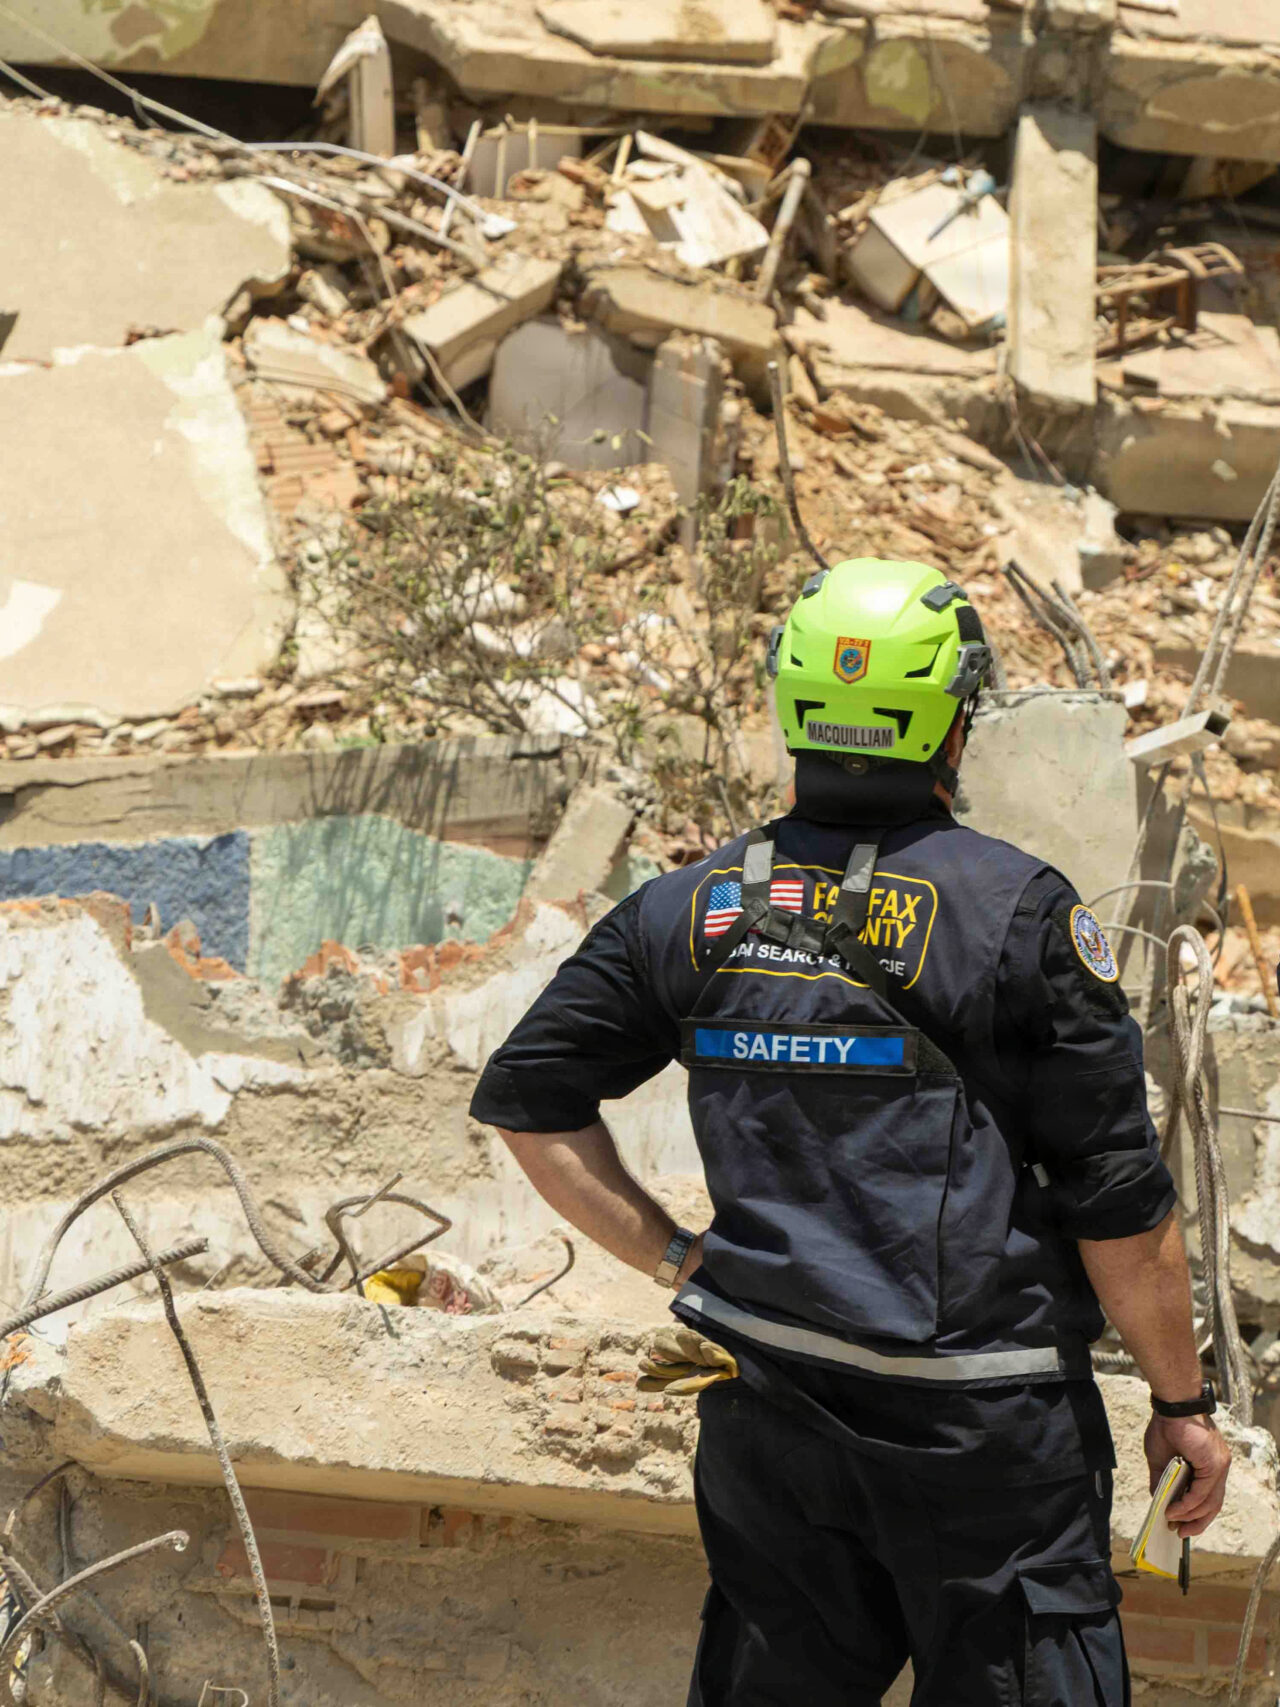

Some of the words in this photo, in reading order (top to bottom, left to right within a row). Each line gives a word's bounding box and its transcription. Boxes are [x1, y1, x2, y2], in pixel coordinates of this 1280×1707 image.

[807, 722, 893, 747] MACQUILLIAM
[813, 882, 922, 923] FAFAX
[733, 1032, 857, 1064] SAFETY
